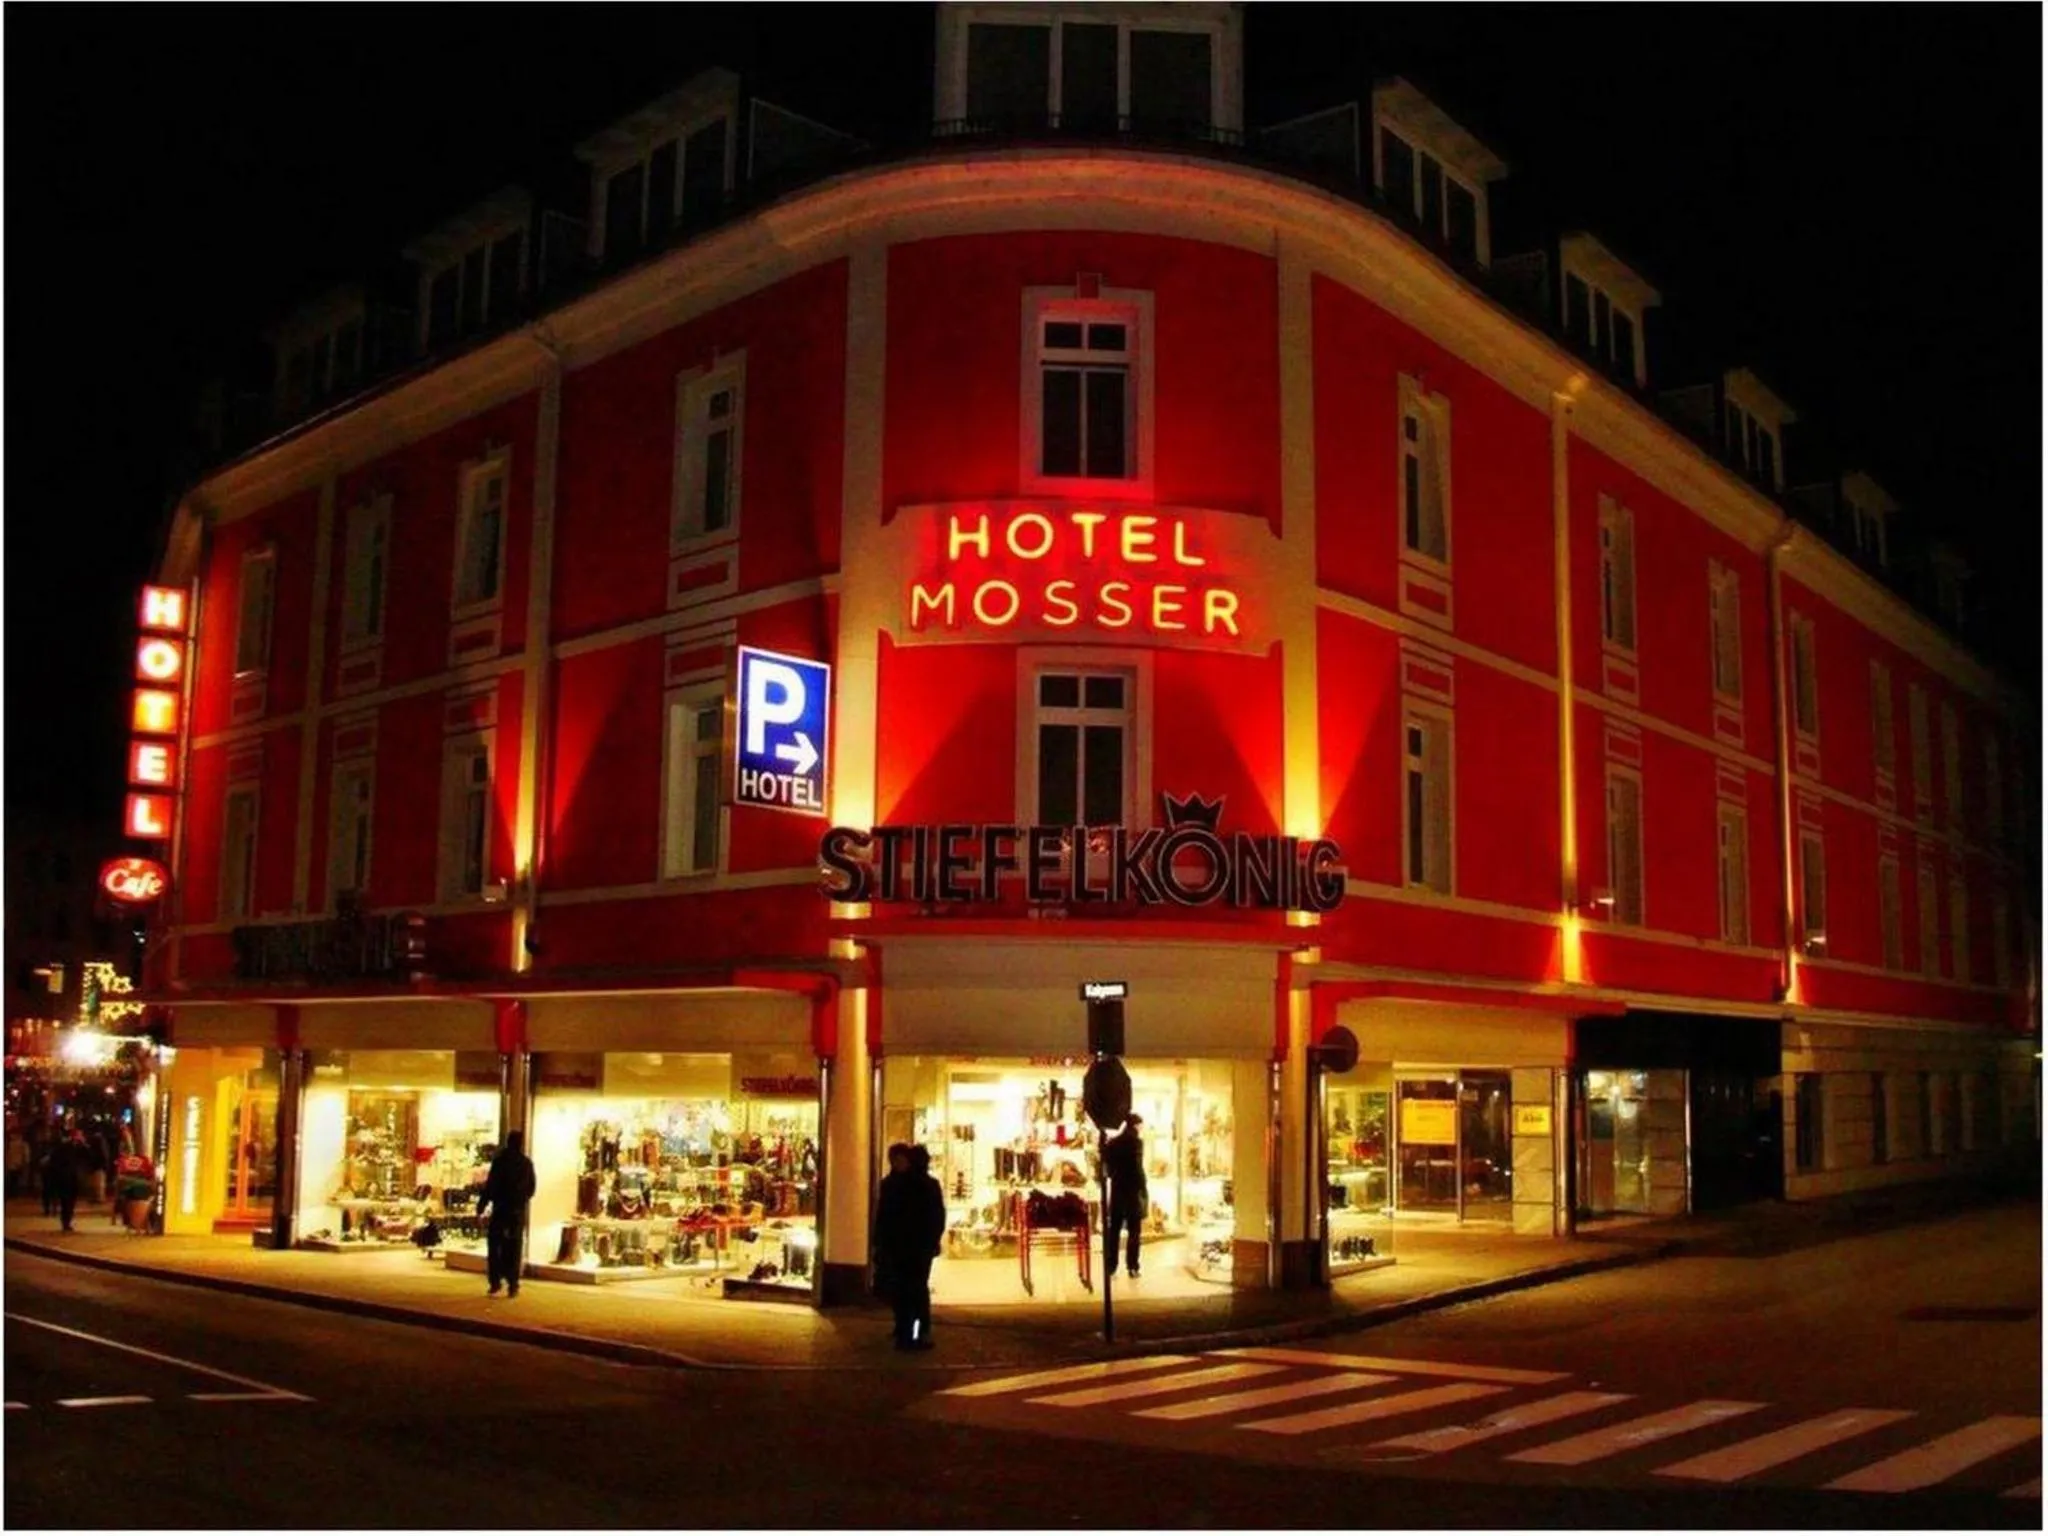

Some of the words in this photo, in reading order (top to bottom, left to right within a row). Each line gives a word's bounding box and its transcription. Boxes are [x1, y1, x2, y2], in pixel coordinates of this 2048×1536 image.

[949, 513, 1206, 566] HOTEL
[911, 580, 1239, 636] MOSSER
[133, 588, 185, 836] HOTEL
[747, 658, 806, 755] P
[741, 768, 822, 808] HOTEL
[818, 822, 1347, 912] STIEFELKÖNIG
